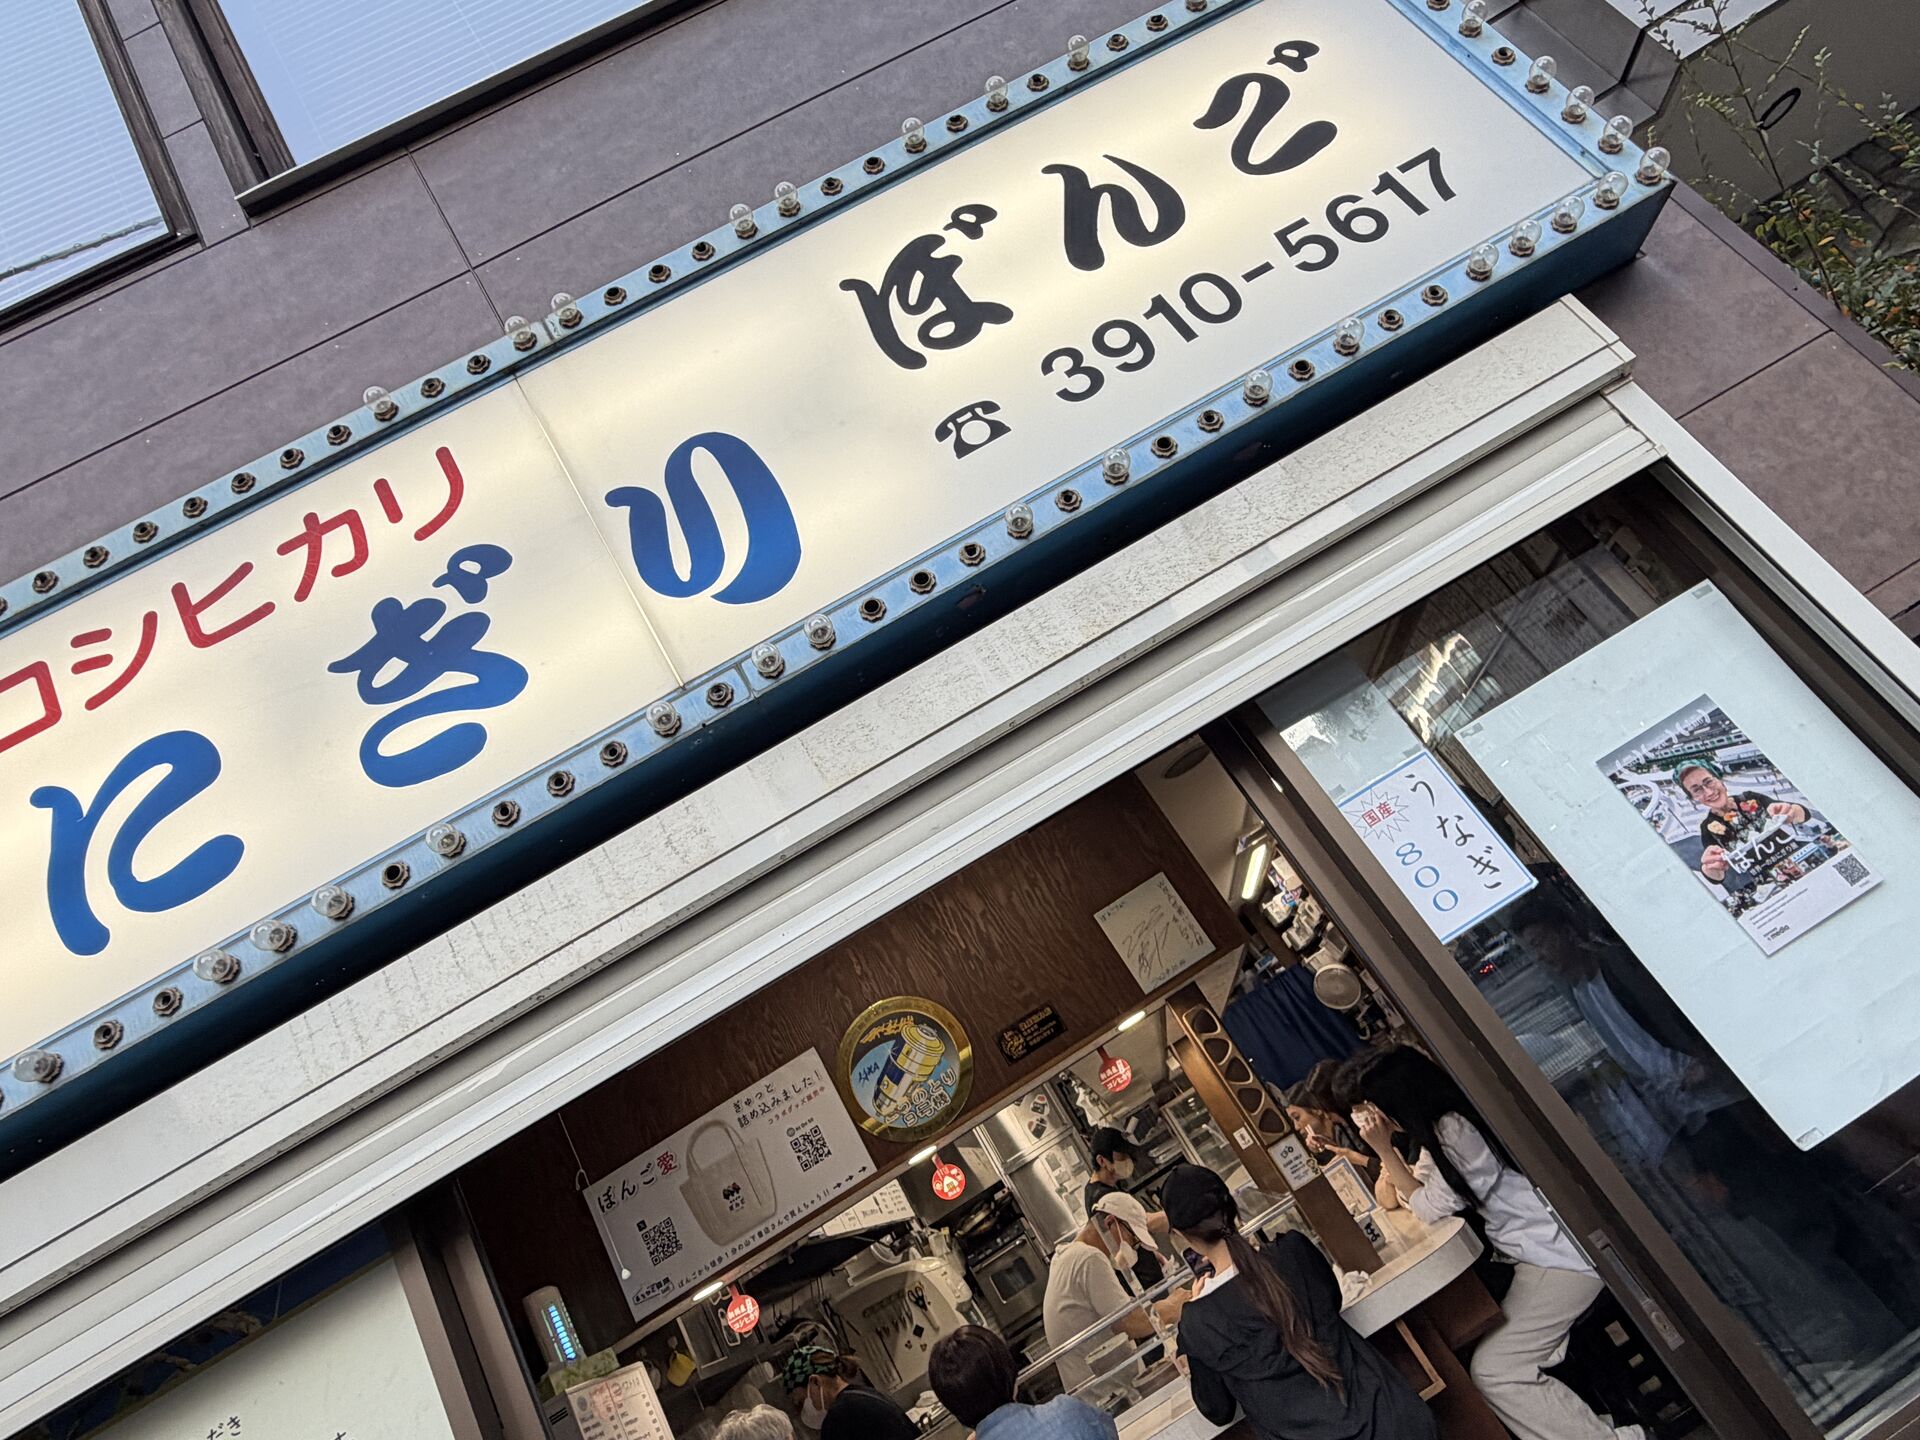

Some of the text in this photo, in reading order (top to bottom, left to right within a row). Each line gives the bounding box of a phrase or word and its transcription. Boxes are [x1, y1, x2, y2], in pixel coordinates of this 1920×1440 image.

[839, 38, 1338, 370] ぼんご
[1040, 147, 1458, 402] 3910-5617
[0, 446, 466, 752] コシヒカリ
[29, 431, 802, 956] にぎり
[1362, 801, 1396, 828] 国産
[1404, 772, 1503, 890] うなぎ
[1395, 842, 1459, 912] 800
[733, 1081, 775, 1114] ぎゅっと
[902, 1087, 952, 1128] 9号機
[597, 1150, 678, 1215] ぼんご愛
